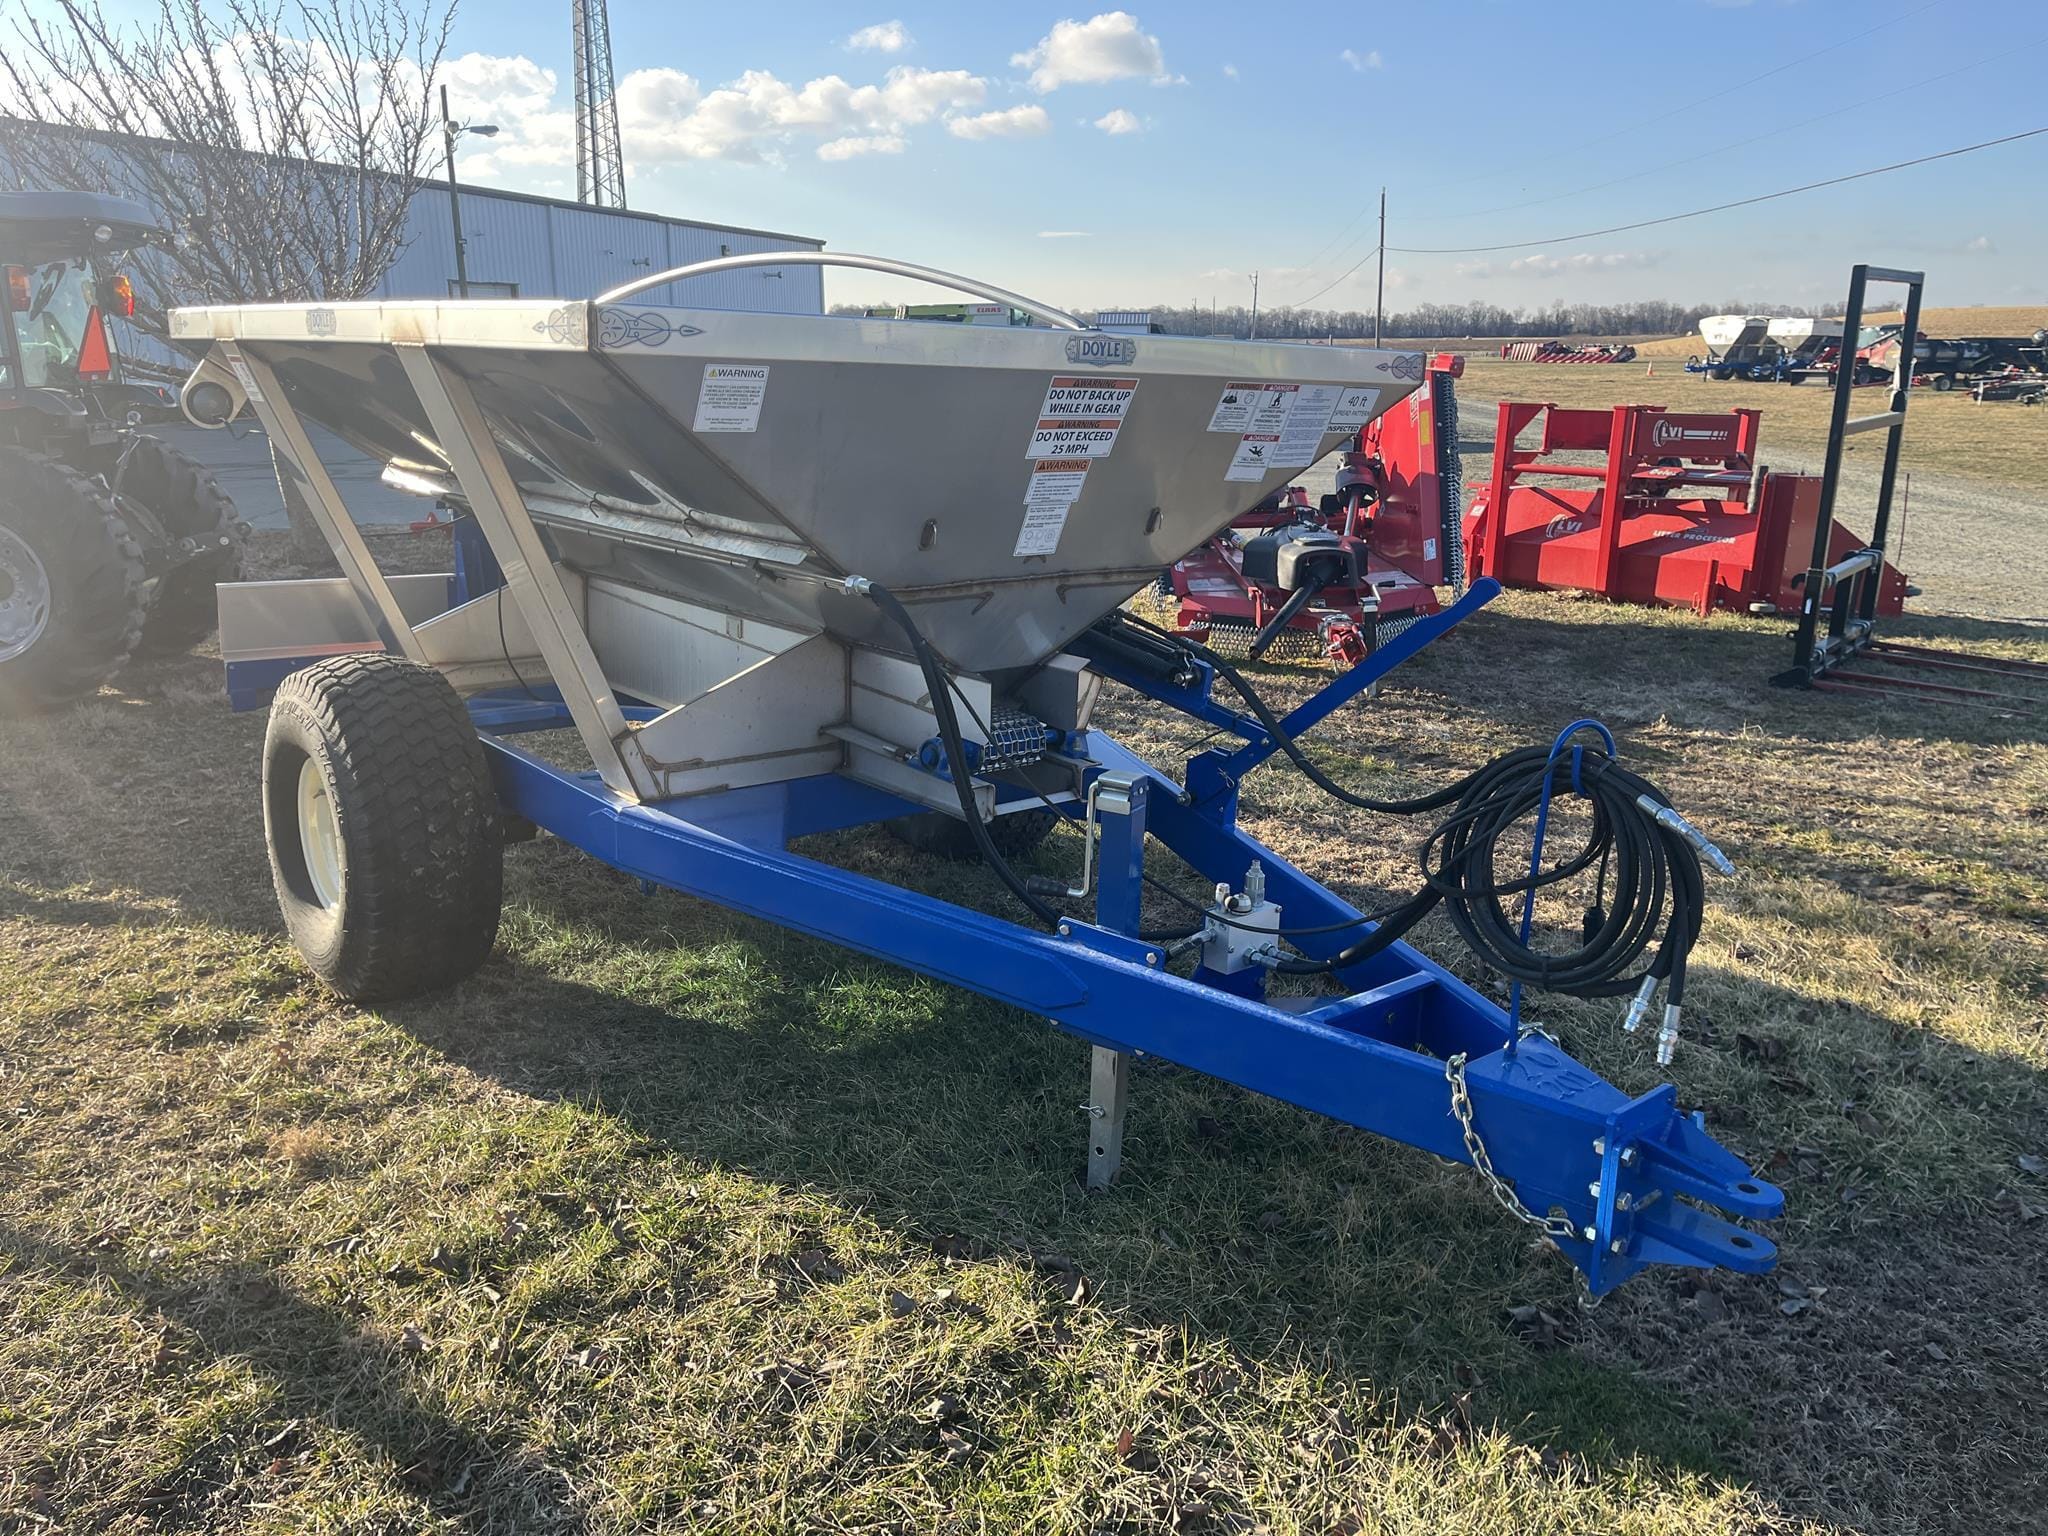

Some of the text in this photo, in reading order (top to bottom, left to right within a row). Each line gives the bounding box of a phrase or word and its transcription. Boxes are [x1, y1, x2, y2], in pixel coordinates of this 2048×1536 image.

[1082, 340, 1120, 357] DOYLE
[718, 369, 765, 378] WARNING
[1078, 379, 1117, 388] WARNING
[1049, 390, 1131, 401] DO NOT BACK UP
[1348, 396, 1368, 407] 40 ft
[1049, 403, 1121, 414] WHILE IN GEAR
[1064, 420, 1100, 429] WARNING
[1036, 431, 1113, 442] DO NOT EXCEED
[1661, 426, 1683, 438] LVI
[1051, 444, 1089, 454] 25 MPH
[1046, 460, 1087, 470] WARNING
[1557, 521, 1583, 532] LVI
[1652, 530, 1736, 544] LITTER PROCESSOR
